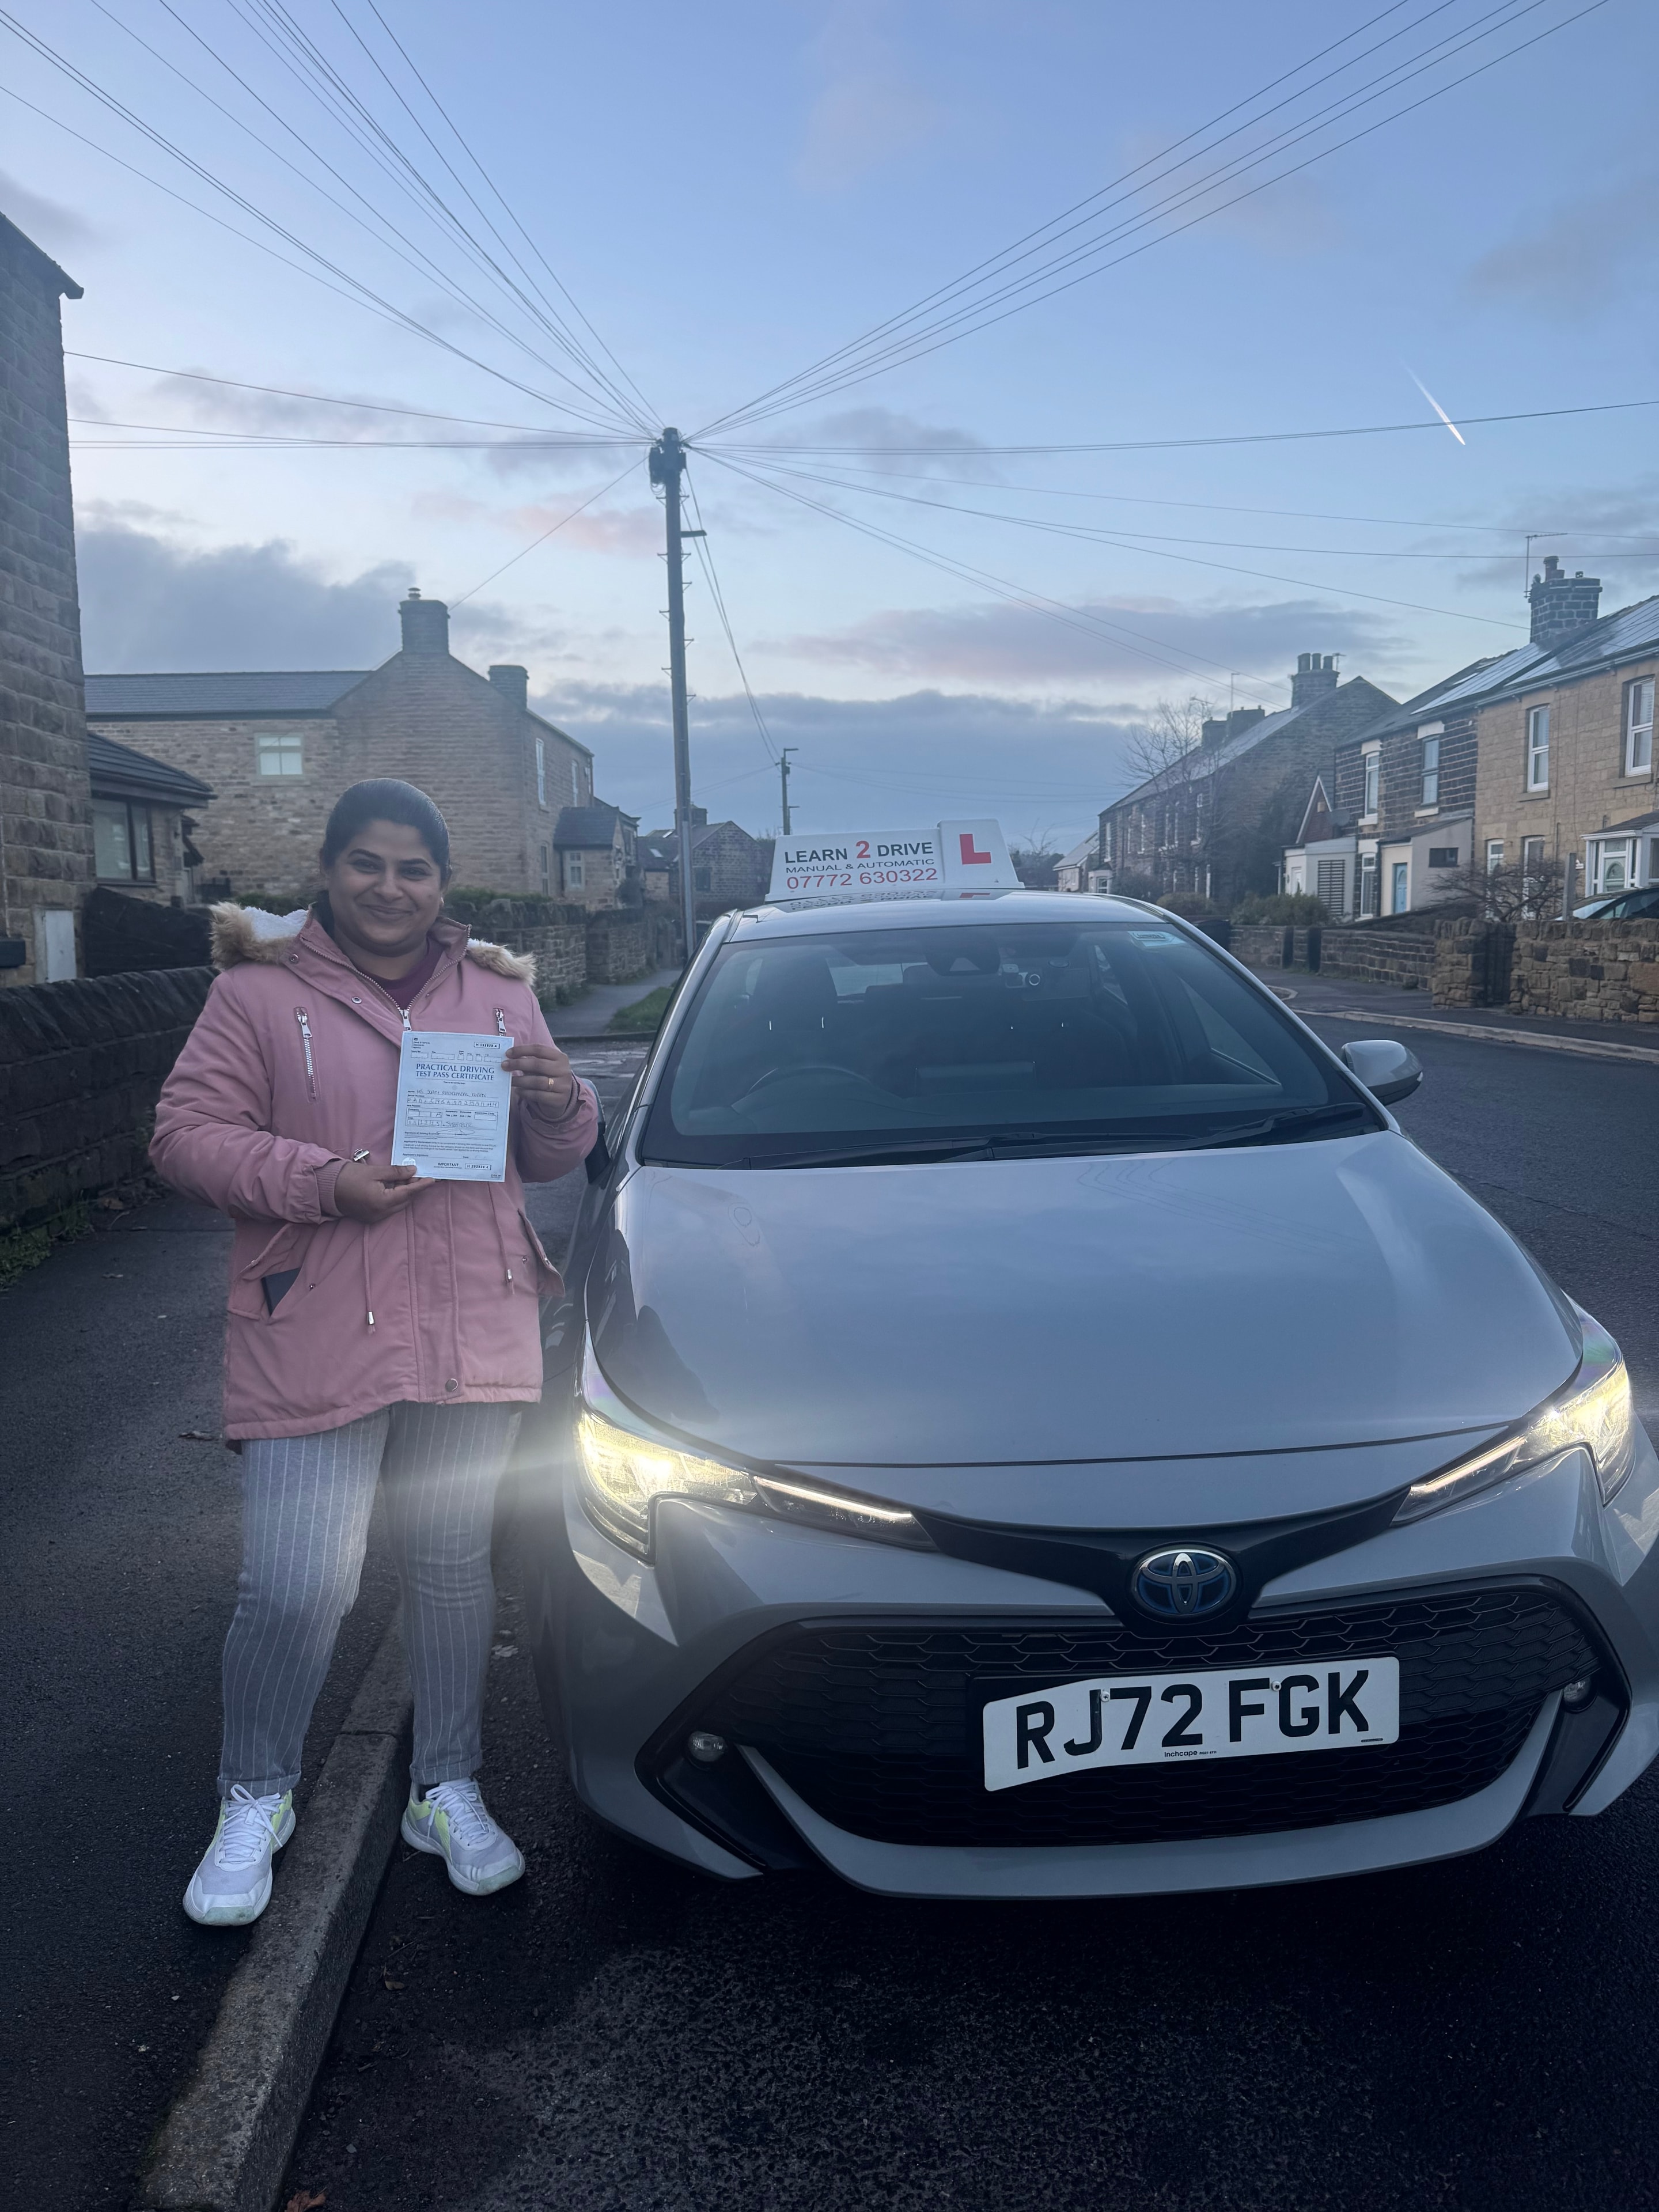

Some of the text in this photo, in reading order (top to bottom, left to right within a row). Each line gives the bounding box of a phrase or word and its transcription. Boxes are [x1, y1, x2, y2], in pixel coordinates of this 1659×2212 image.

[785, 840, 933, 863] LEARN 2 DRIVE
[959, 834, 991, 865] L
[786, 865, 842, 873] MANUAL
[857, 859, 934, 869] AUTOMATIC
[787, 868, 938, 889] 07772 630322
[416, 1063, 494, 1074] PRACTICAL DRIVING
[451, 1072, 494, 1081] CERTIFICATE
[1016, 1670, 1369, 1769] RJ72 FGK
